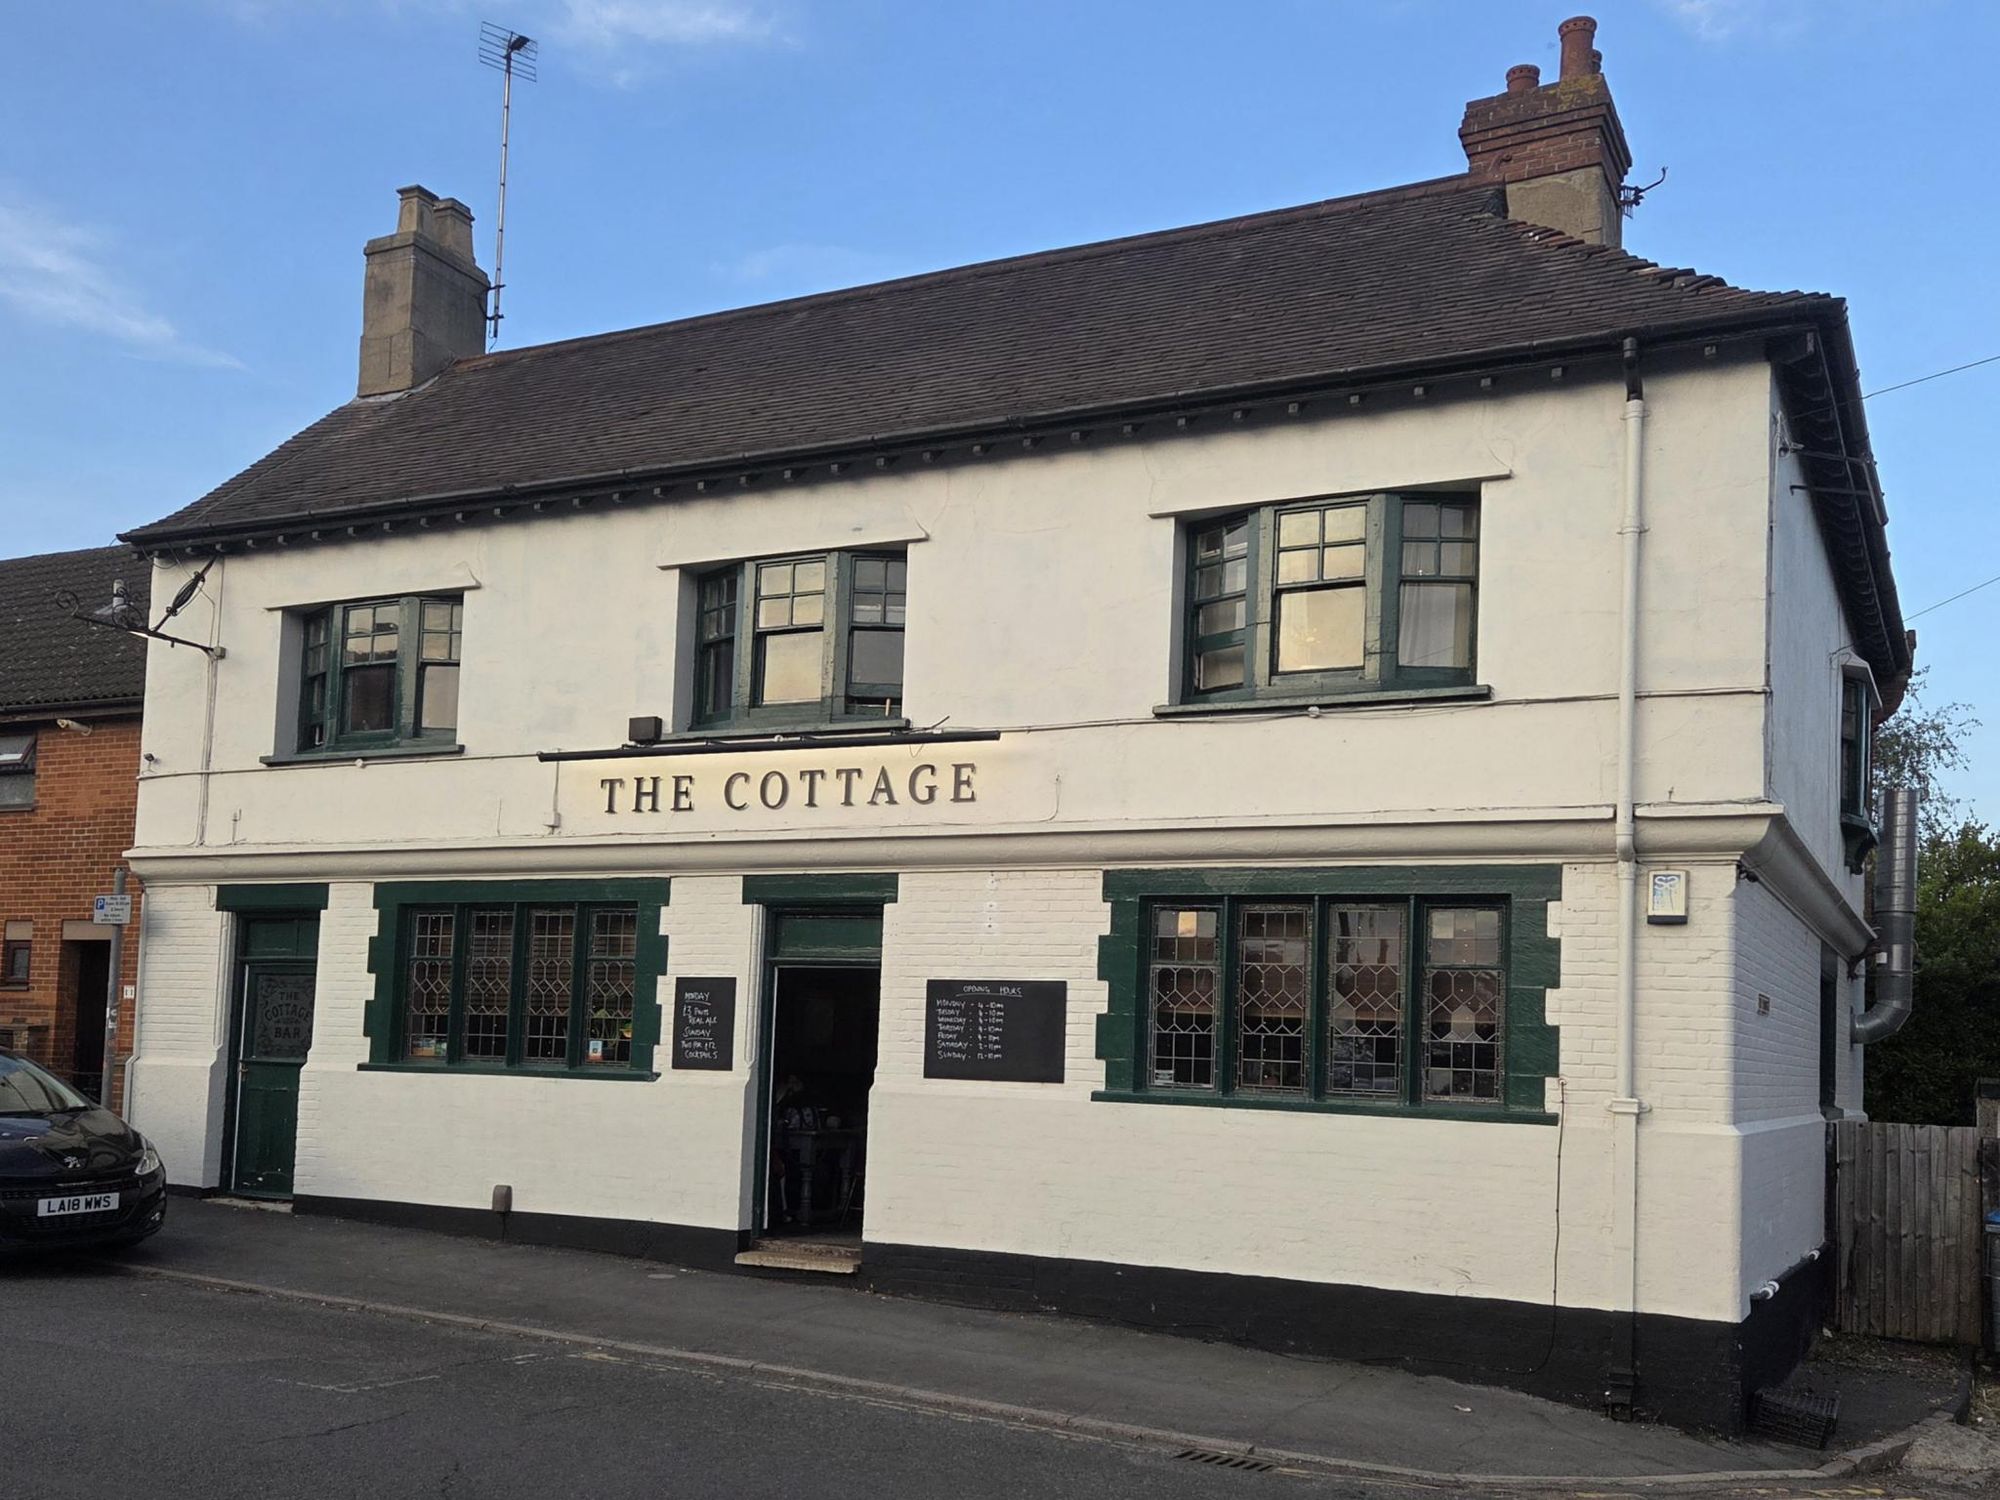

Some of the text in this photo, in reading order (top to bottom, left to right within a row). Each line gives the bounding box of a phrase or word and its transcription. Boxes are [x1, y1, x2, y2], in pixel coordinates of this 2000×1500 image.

[600, 763, 977, 814] THE COTTAGE
[280, 991, 301, 1001] THE
[684, 991, 710, 1001] MONDAY
[963, 985, 1022, 996] OPENING HOURS
[936, 999, 966, 1009] MONDAY
[264, 1003, 311, 1021] COTTAGE
[274, 1027, 301, 1039] BAR
[682, 1026, 711, 1038] SUNDAY
[684, 1050, 719, 1059] COCKTAILS
[937, 1050, 967, 1061] SUNDAY
[47, 1195, 111, 1213] LA18 WWS
